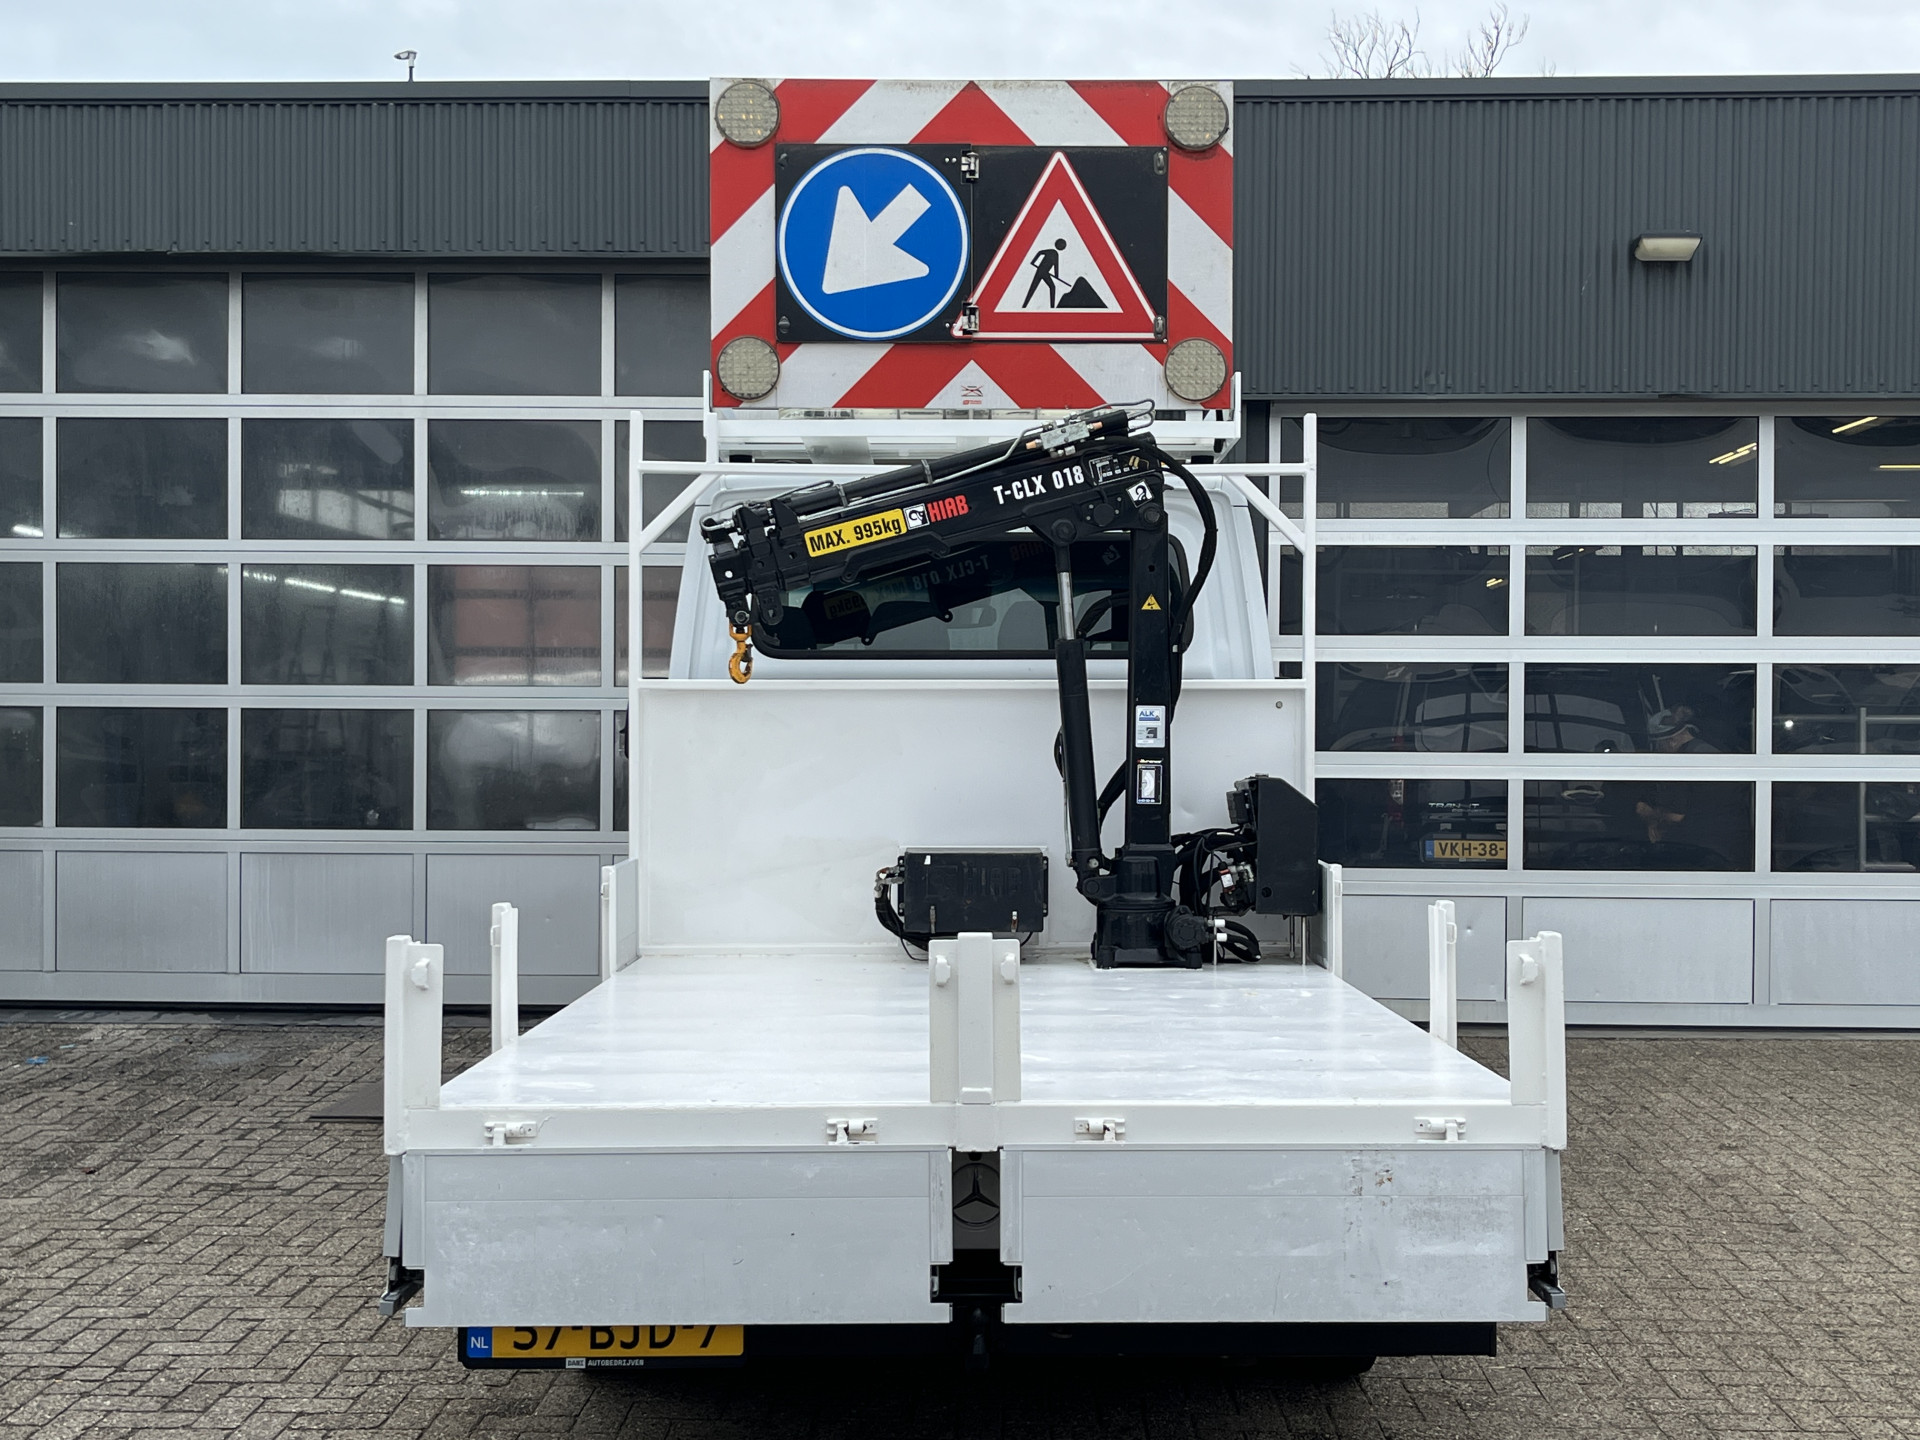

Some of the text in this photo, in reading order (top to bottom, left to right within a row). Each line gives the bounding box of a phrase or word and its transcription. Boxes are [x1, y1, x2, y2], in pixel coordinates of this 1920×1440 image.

[993, 465, 1085, 505] T-CLX 018
[927, 494, 969, 523] HIAB
[809, 517, 902, 553] MAX. 995kg
[470, 1336, 489, 1349] NL
[587, 1359, 645, 1367] AUTOBEDRIJVEN
